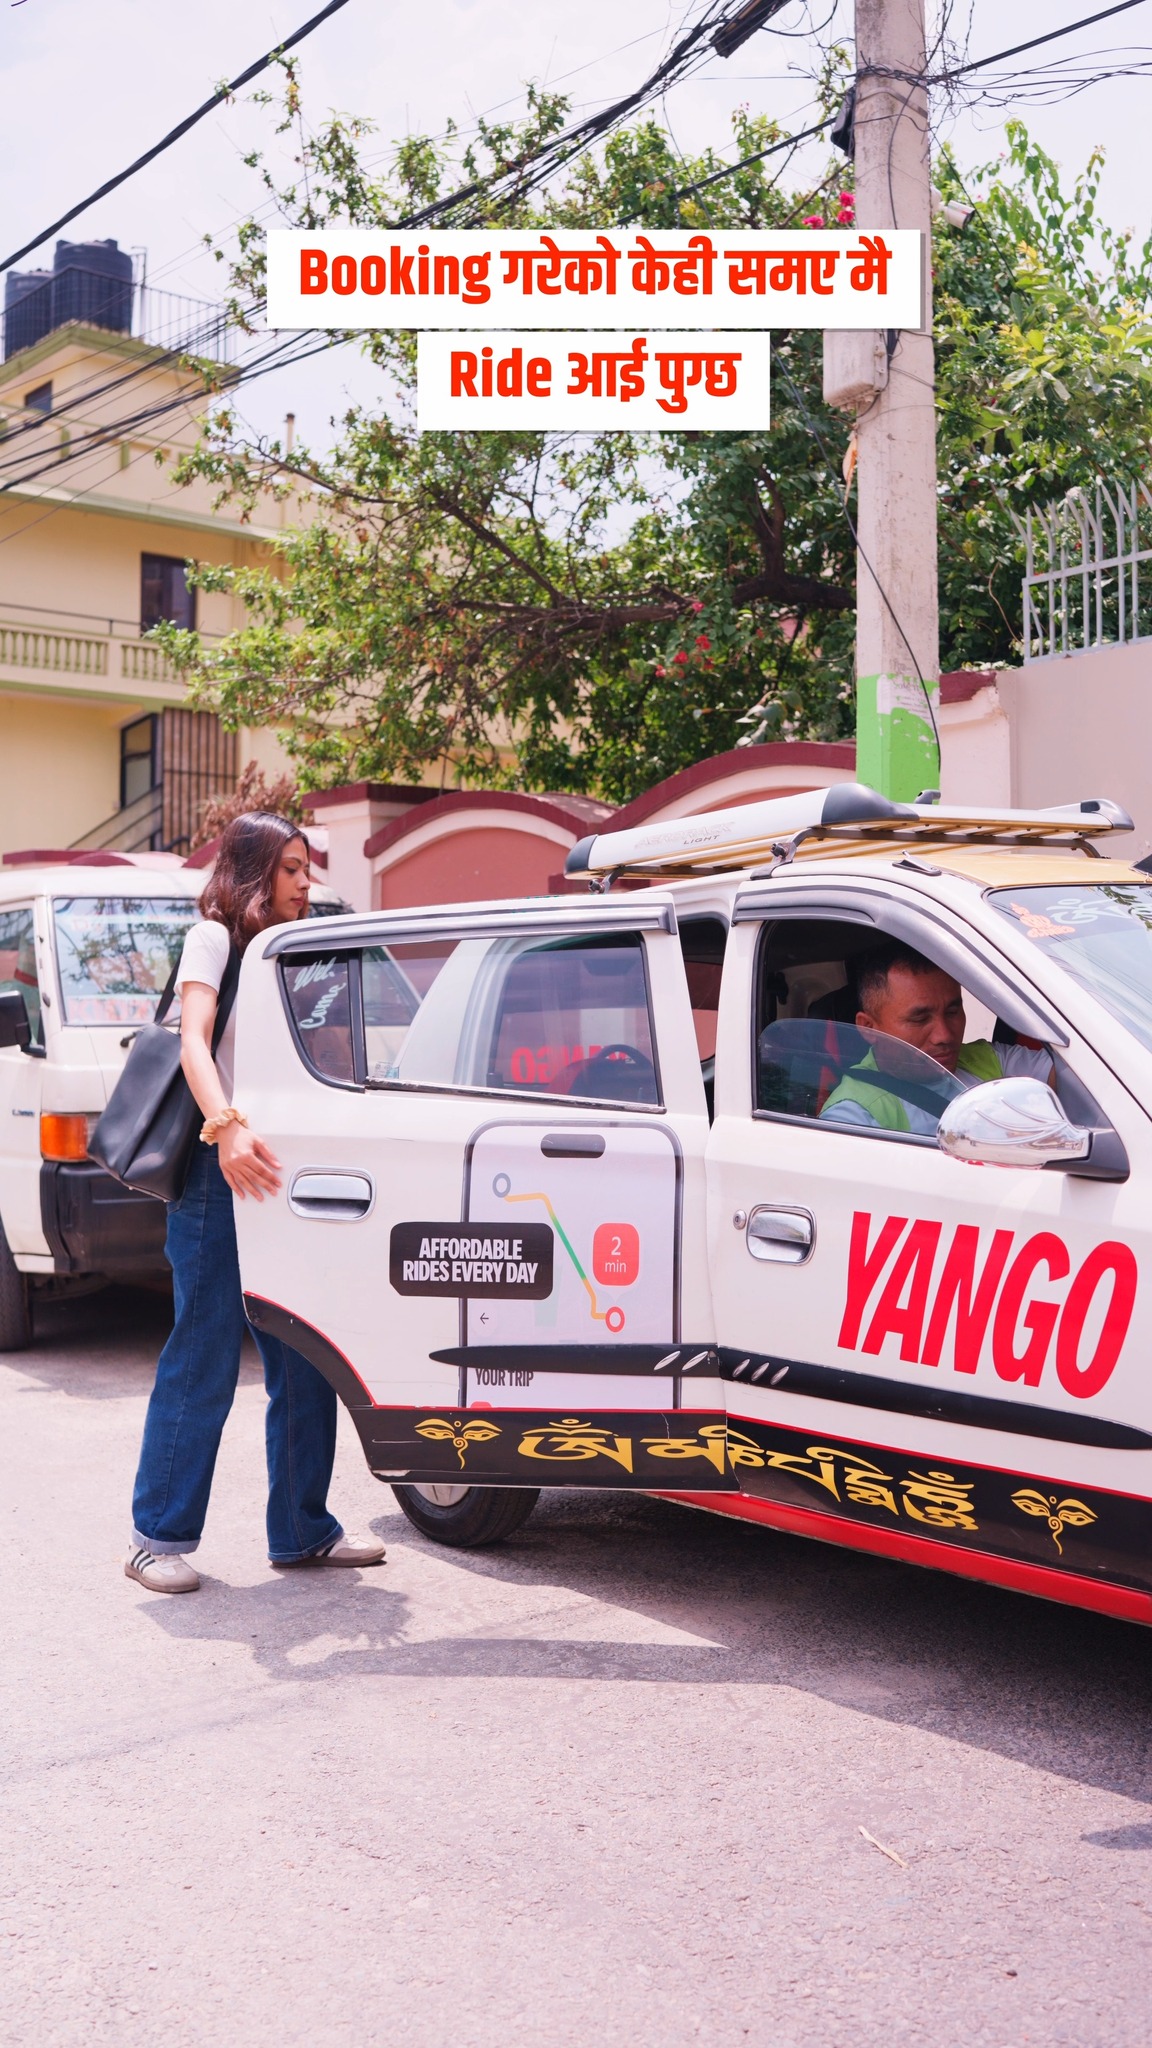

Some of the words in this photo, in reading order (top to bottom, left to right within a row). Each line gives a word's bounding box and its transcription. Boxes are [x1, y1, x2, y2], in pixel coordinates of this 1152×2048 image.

[683, 834, 721, 845] LIGHT
[418, 1237, 523, 1260] AFFORDABLE
[610, 1236, 622, 1256] 2
[402, 1260, 450, 1282] RIDES
[452, 1261, 504, 1283] EVERY
[506, 1262, 539, 1284] DAY
[604, 1259, 627, 1273] min
[838, 1212, 1138, 1399] YANGO
[475, 1368, 506, 1387] YOUR
[507, 1370, 534, 1387] TRIP
